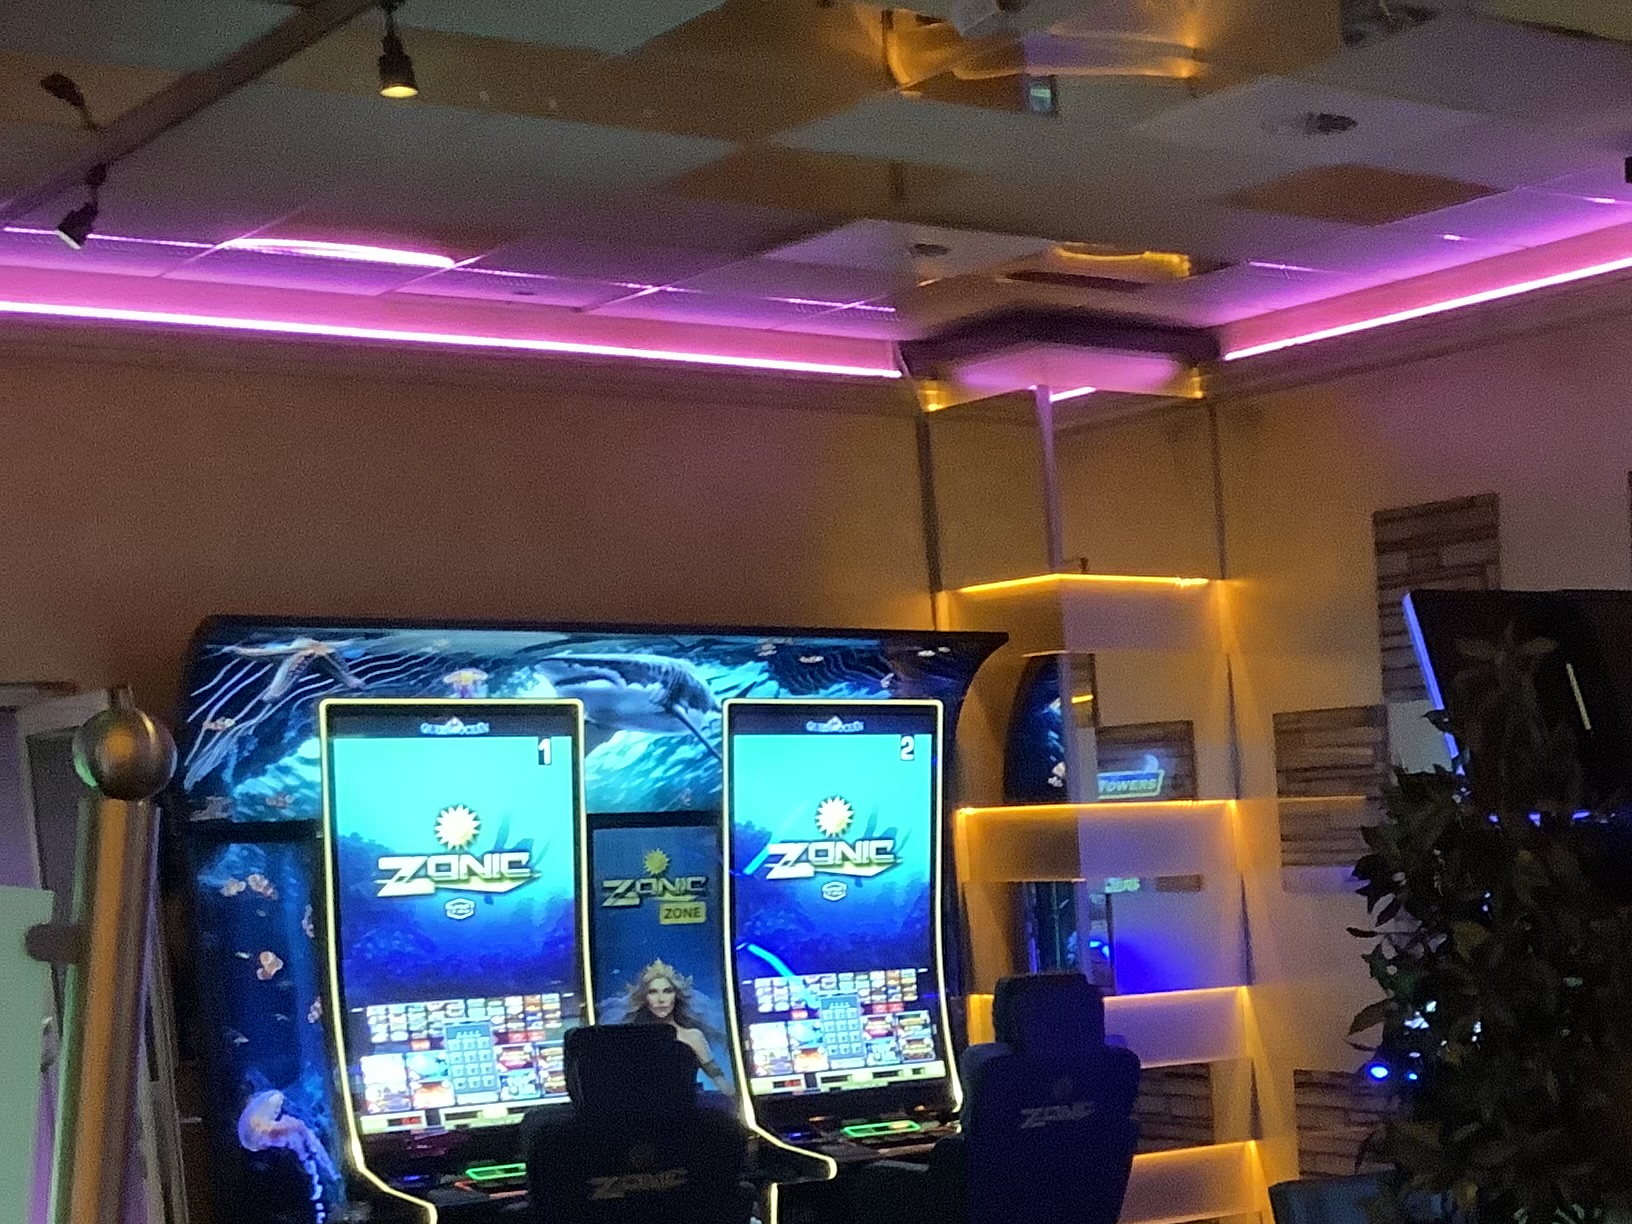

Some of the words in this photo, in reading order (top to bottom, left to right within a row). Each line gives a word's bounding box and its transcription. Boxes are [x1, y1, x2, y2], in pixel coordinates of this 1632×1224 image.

[538, 738, 551, 765] 1
[901, 736, 914, 761] 2
[376, 852, 536, 897] ZONIC
[766, 840, 899, 880] ZONIC
[601, 876, 708, 907] ZONIC
[663, 907, 701, 919] ZONE
